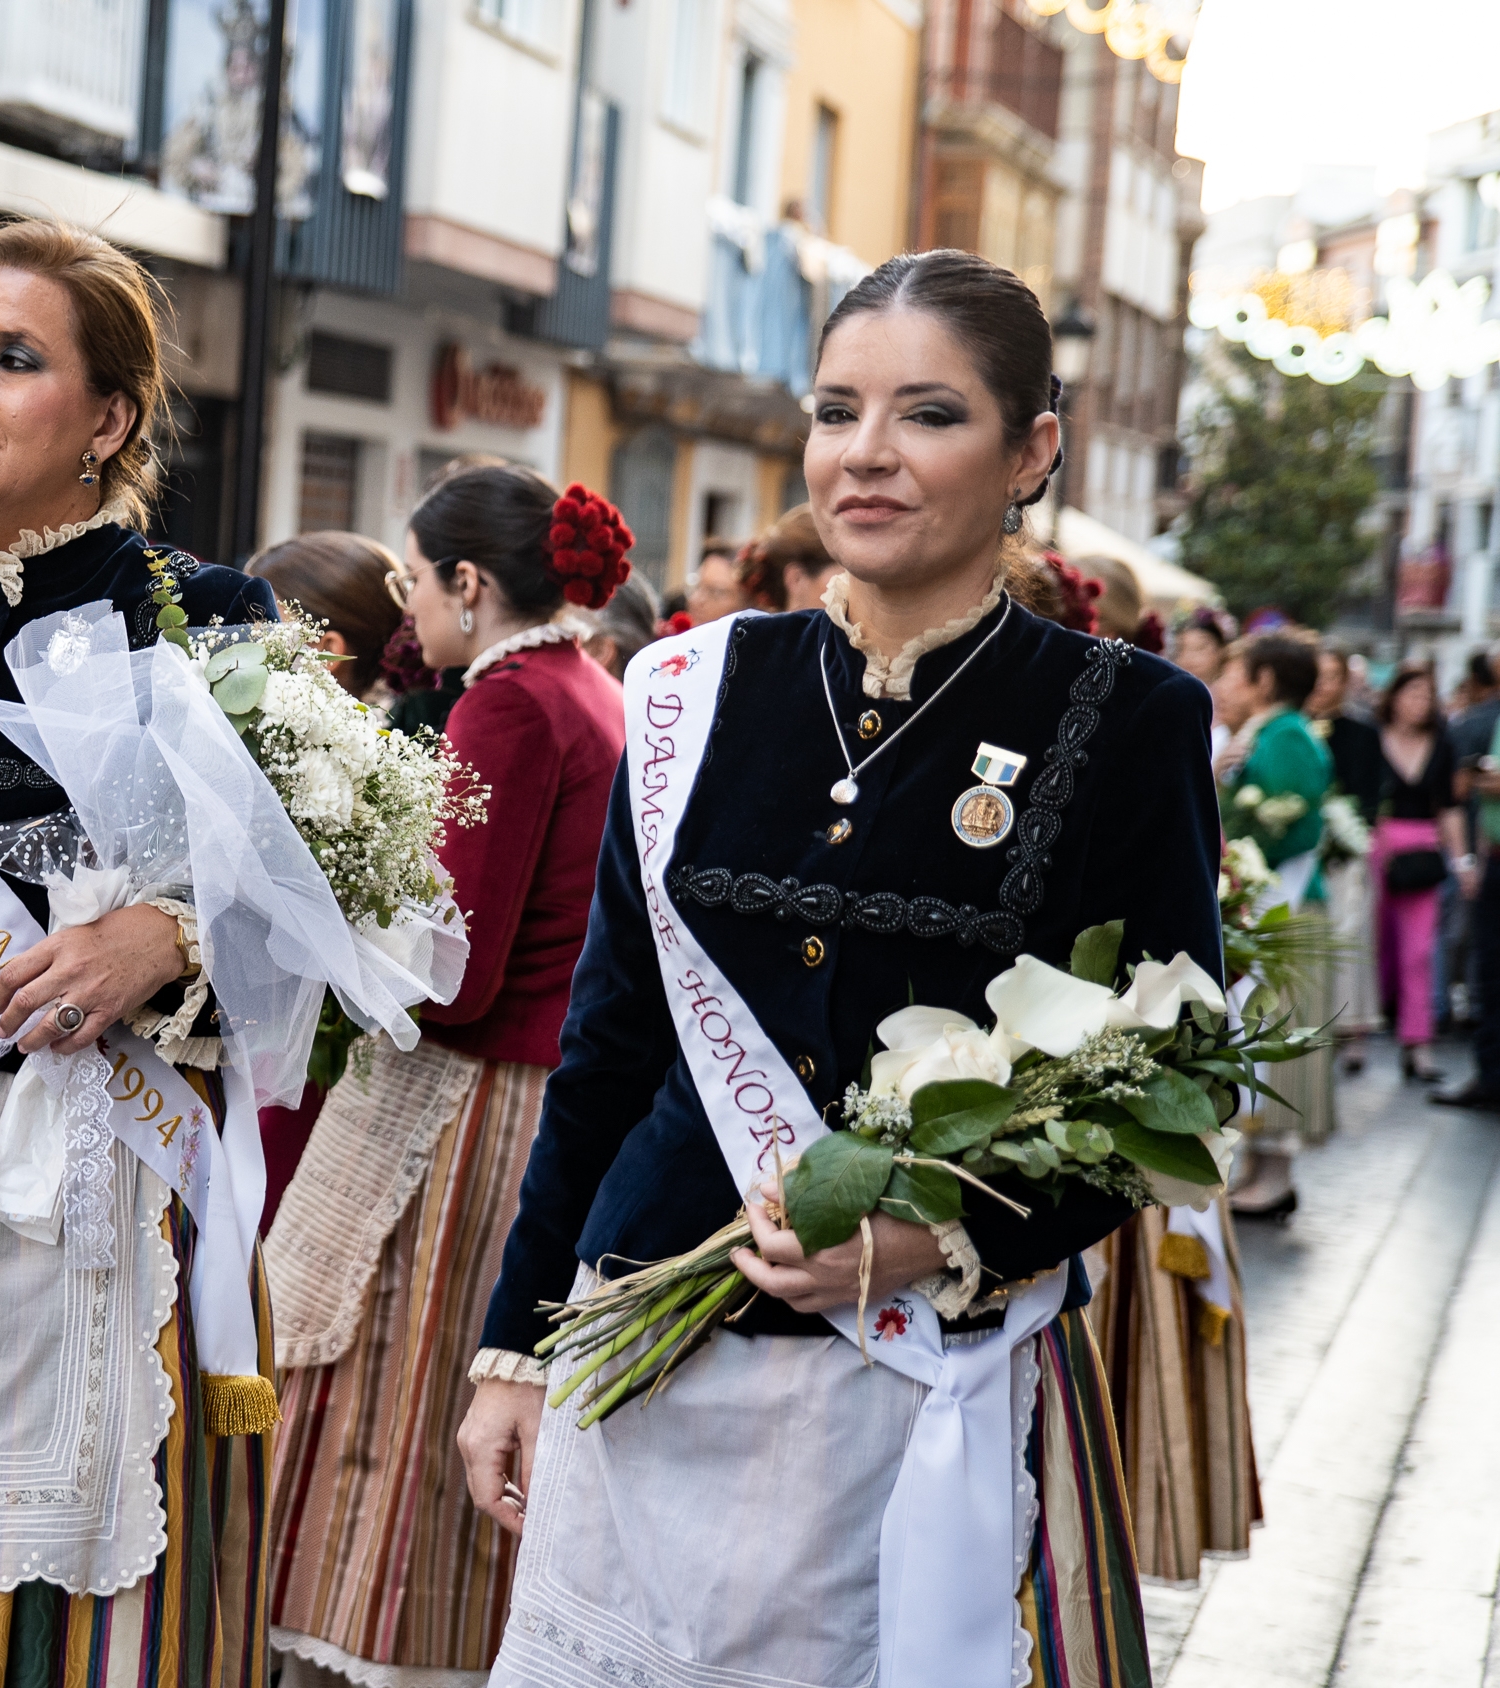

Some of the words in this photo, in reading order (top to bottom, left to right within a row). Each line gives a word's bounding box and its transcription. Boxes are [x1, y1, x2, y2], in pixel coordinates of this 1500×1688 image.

[641, 693, 684, 866] DAMA
[646, 873, 681, 952] DE
[104, 1052, 184, 1149] 1994
[677, 969, 796, 1172] HONOR
